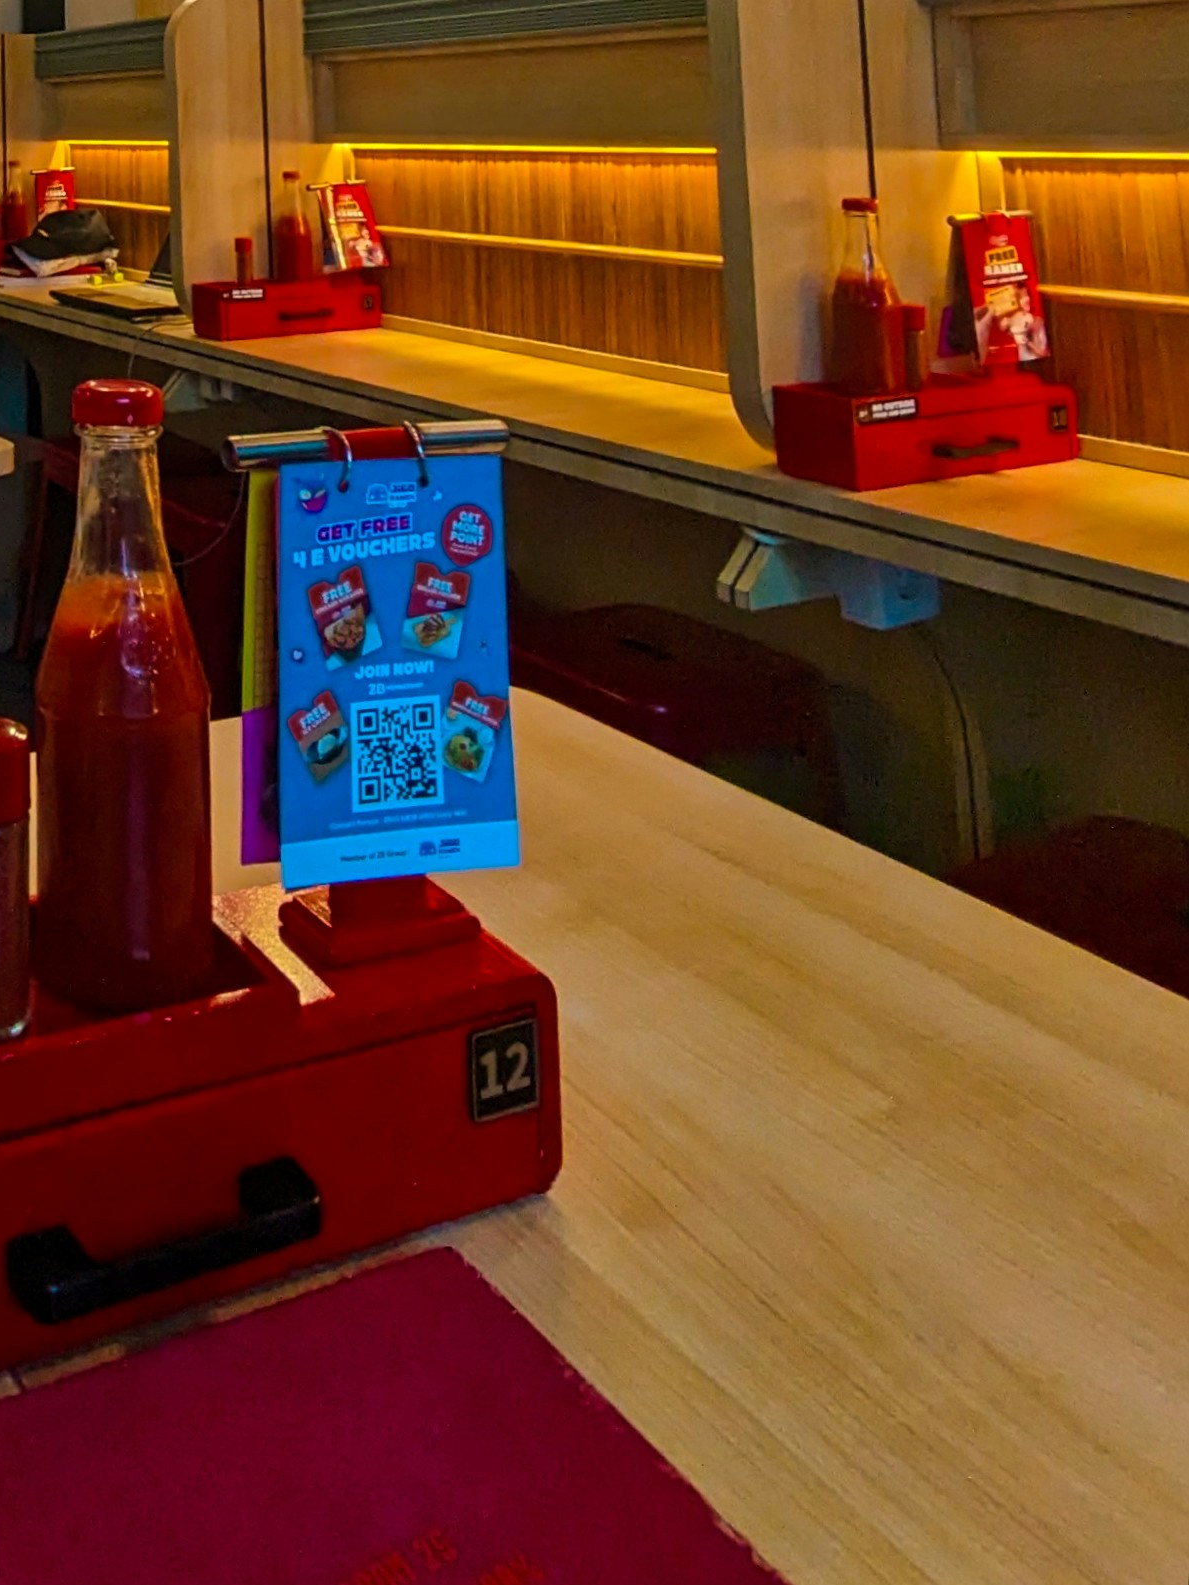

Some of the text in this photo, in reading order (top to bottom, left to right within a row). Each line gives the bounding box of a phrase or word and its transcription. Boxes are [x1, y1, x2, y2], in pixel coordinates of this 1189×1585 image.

[988, 249, 1015, 264] FREE
[459, 510, 481, 524] GET
[317, 514, 412, 543] GET FREE
[450, 531, 485, 546] POINT
[293, 550, 307, 568] 4
[327, 531, 436, 563] VOUCHERS
[322, 581, 352, 604] FREE
[428, 577, 453, 595] FREE
[354, 660, 434, 680] JOIN NOW!
[300, 703, 328, 729] FREE
[465, 697, 490, 715] FREE
[479, 1041, 531, 1099] 12
